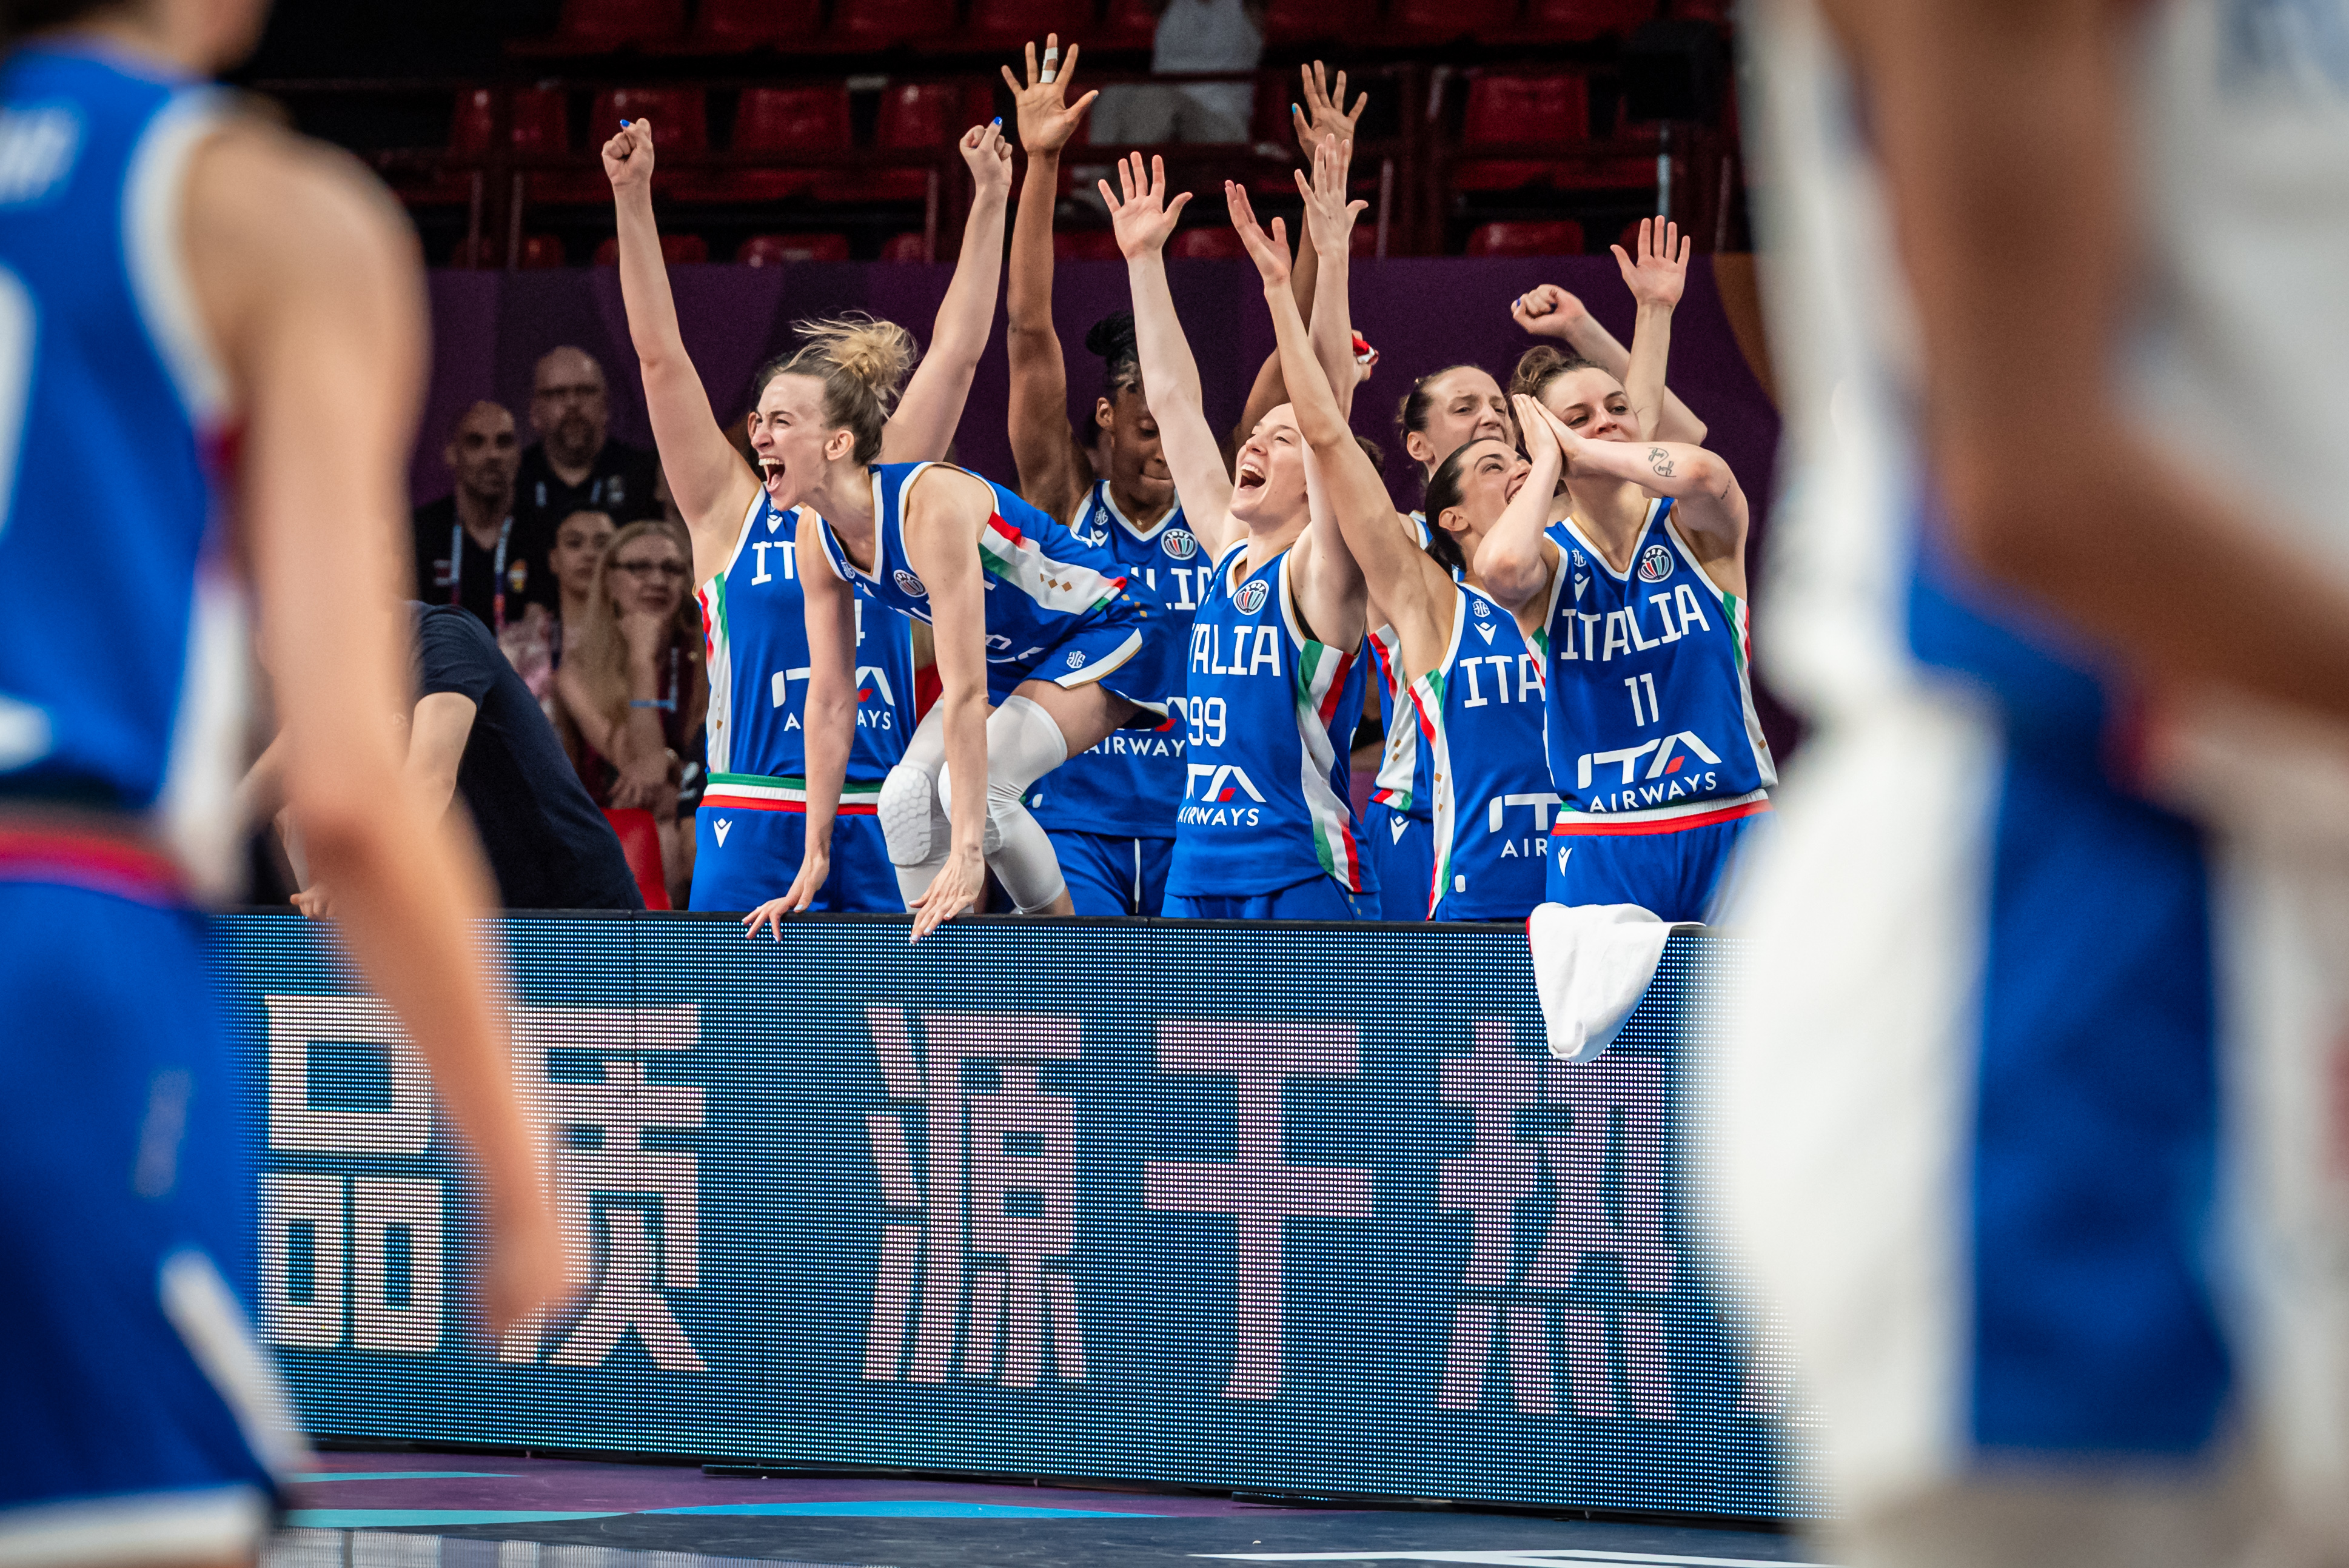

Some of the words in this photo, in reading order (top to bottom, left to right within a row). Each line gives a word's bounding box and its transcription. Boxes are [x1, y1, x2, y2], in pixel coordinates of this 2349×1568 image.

[1561, 584, 1711, 662] ITALIA
[1459, 653, 1546, 708] ITA
[1624, 672, 1659, 727] 11
[783, 709, 891, 731] AAYS
[1188, 696, 1227, 747] 99
[1084, 736, 1185, 757] AIRWAY
[1578, 731, 1723, 789] ITA
[1186, 763, 1267, 802] TA
[1590, 772, 1717, 812] AIRWAYS
[1178, 806, 1259, 826] AIRWAYS
[1489, 792, 1562, 833] IT
[862, 1002, 1810, 1422] 源于热
